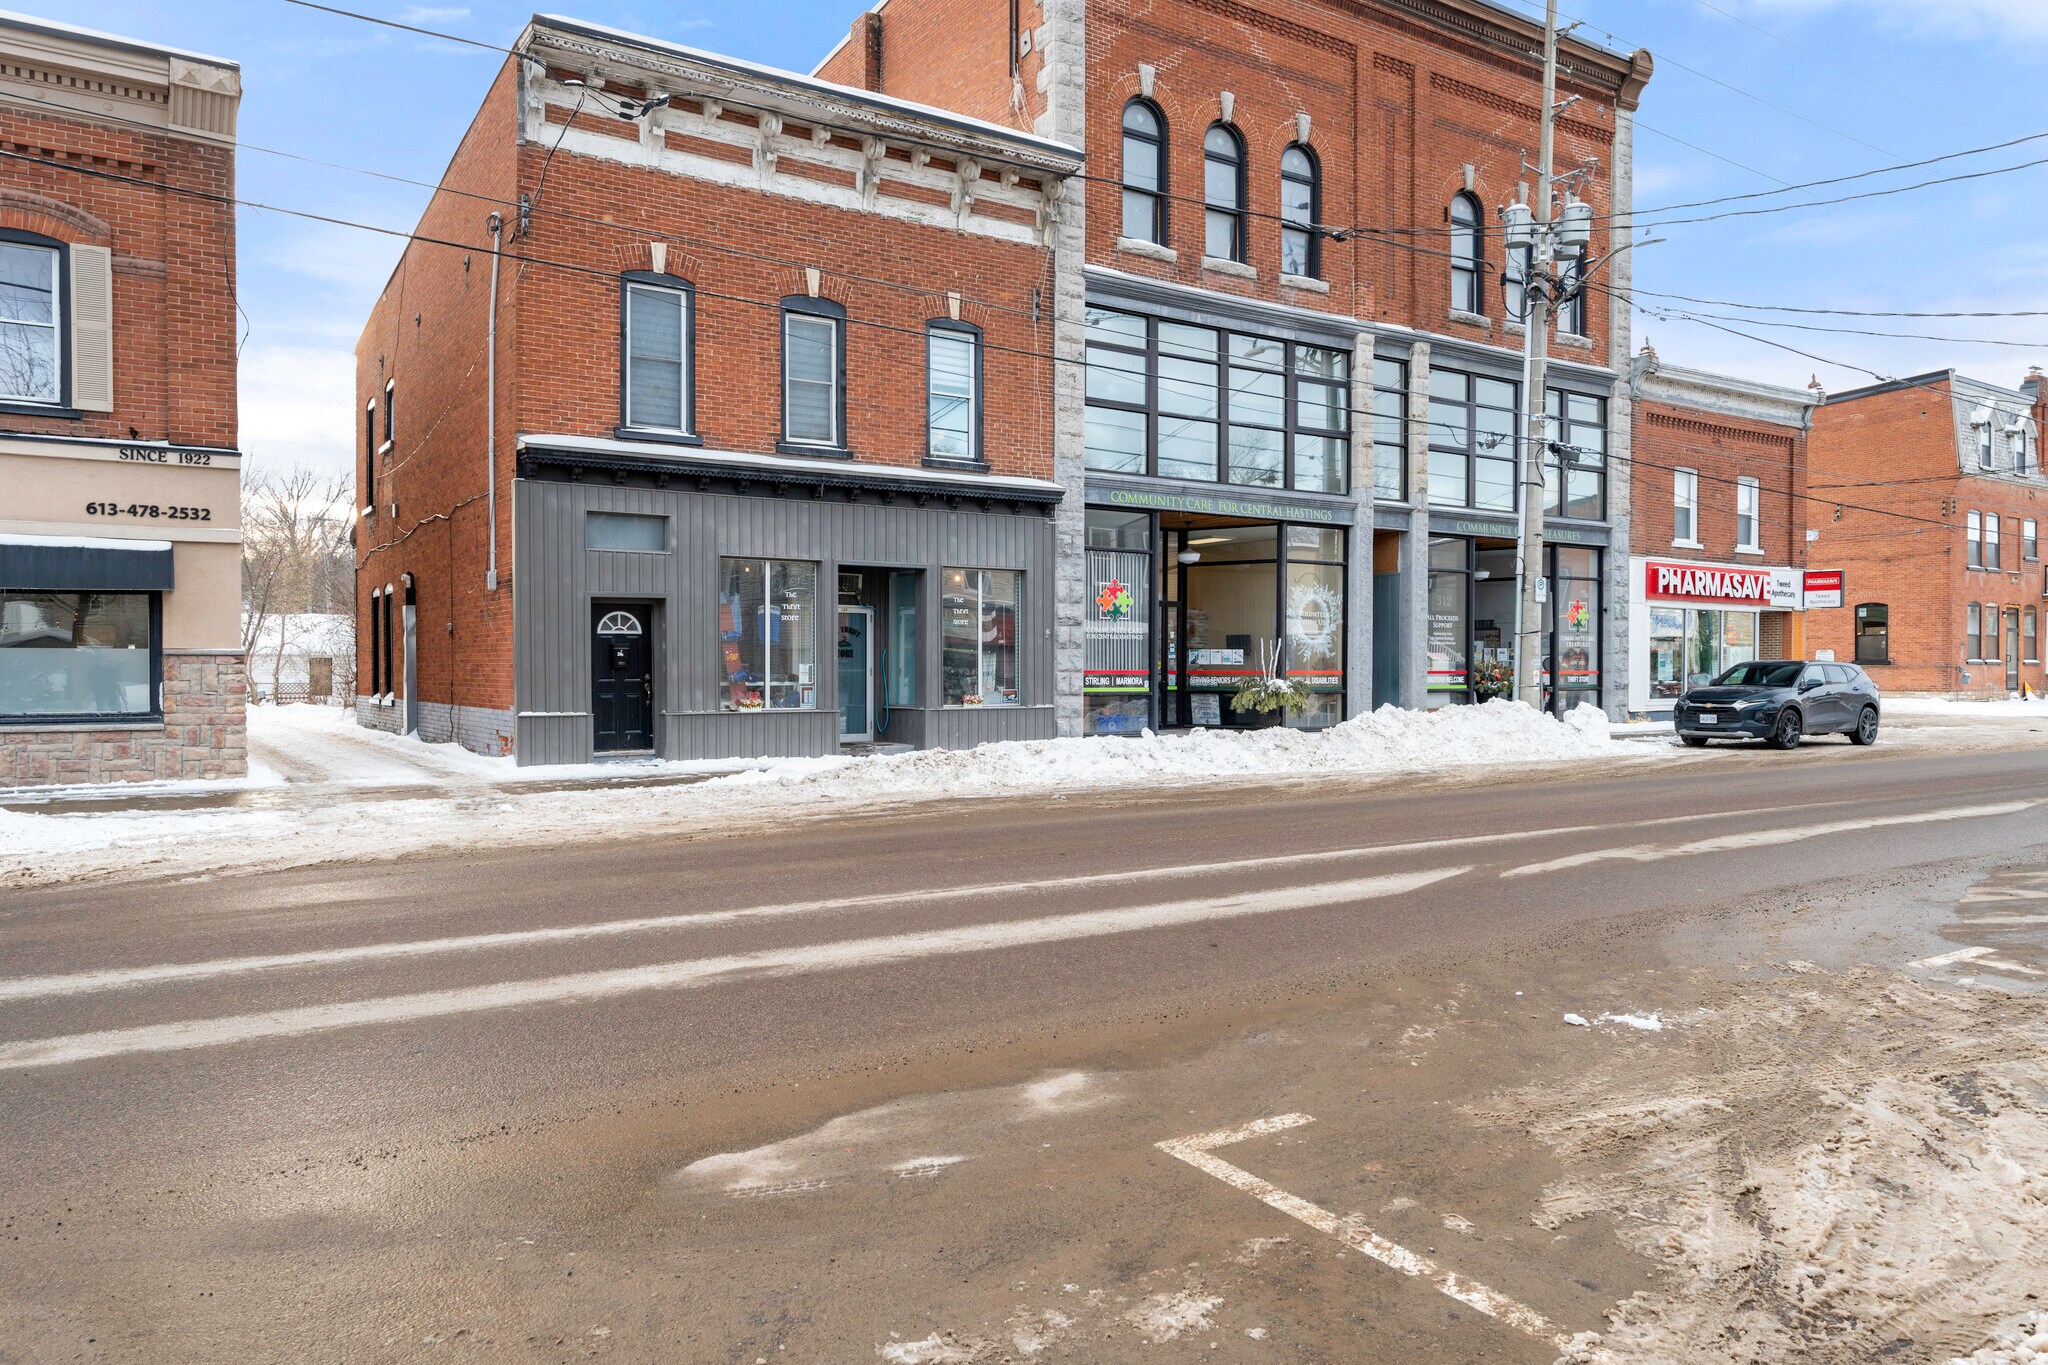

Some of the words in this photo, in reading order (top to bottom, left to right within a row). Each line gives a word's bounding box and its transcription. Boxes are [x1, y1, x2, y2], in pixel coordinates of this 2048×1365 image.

[119, 448, 167, 463] SINCE
[178, 452, 211, 465] 1922
[86, 502, 211, 521] 613-478-2532
[1110, 490, 1184, 508] COMMUNITY
[1186, 498, 1213, 511] CARE
[1219, 500, 1238, 513] FOR
[1240, 503, 1283, 517] CENTRAL
[1286, 507, 1332, 521] HASTINGS
[1456, 521, 1512, 536] COMMUNITY
[1543, 529, 1581, 541] REASURES
[1657, 567, 1771, 600] PHARMASAVE
[1777, 580, 1791, 588] Tweed
[1807, 578, 1838, 586] PHARMASAVE
[1771, 590, 1796, 599] Apothecary
[1085, 677, 1110, 685] STIRLING
[1115, 677, 1143, 685] MARMORA
